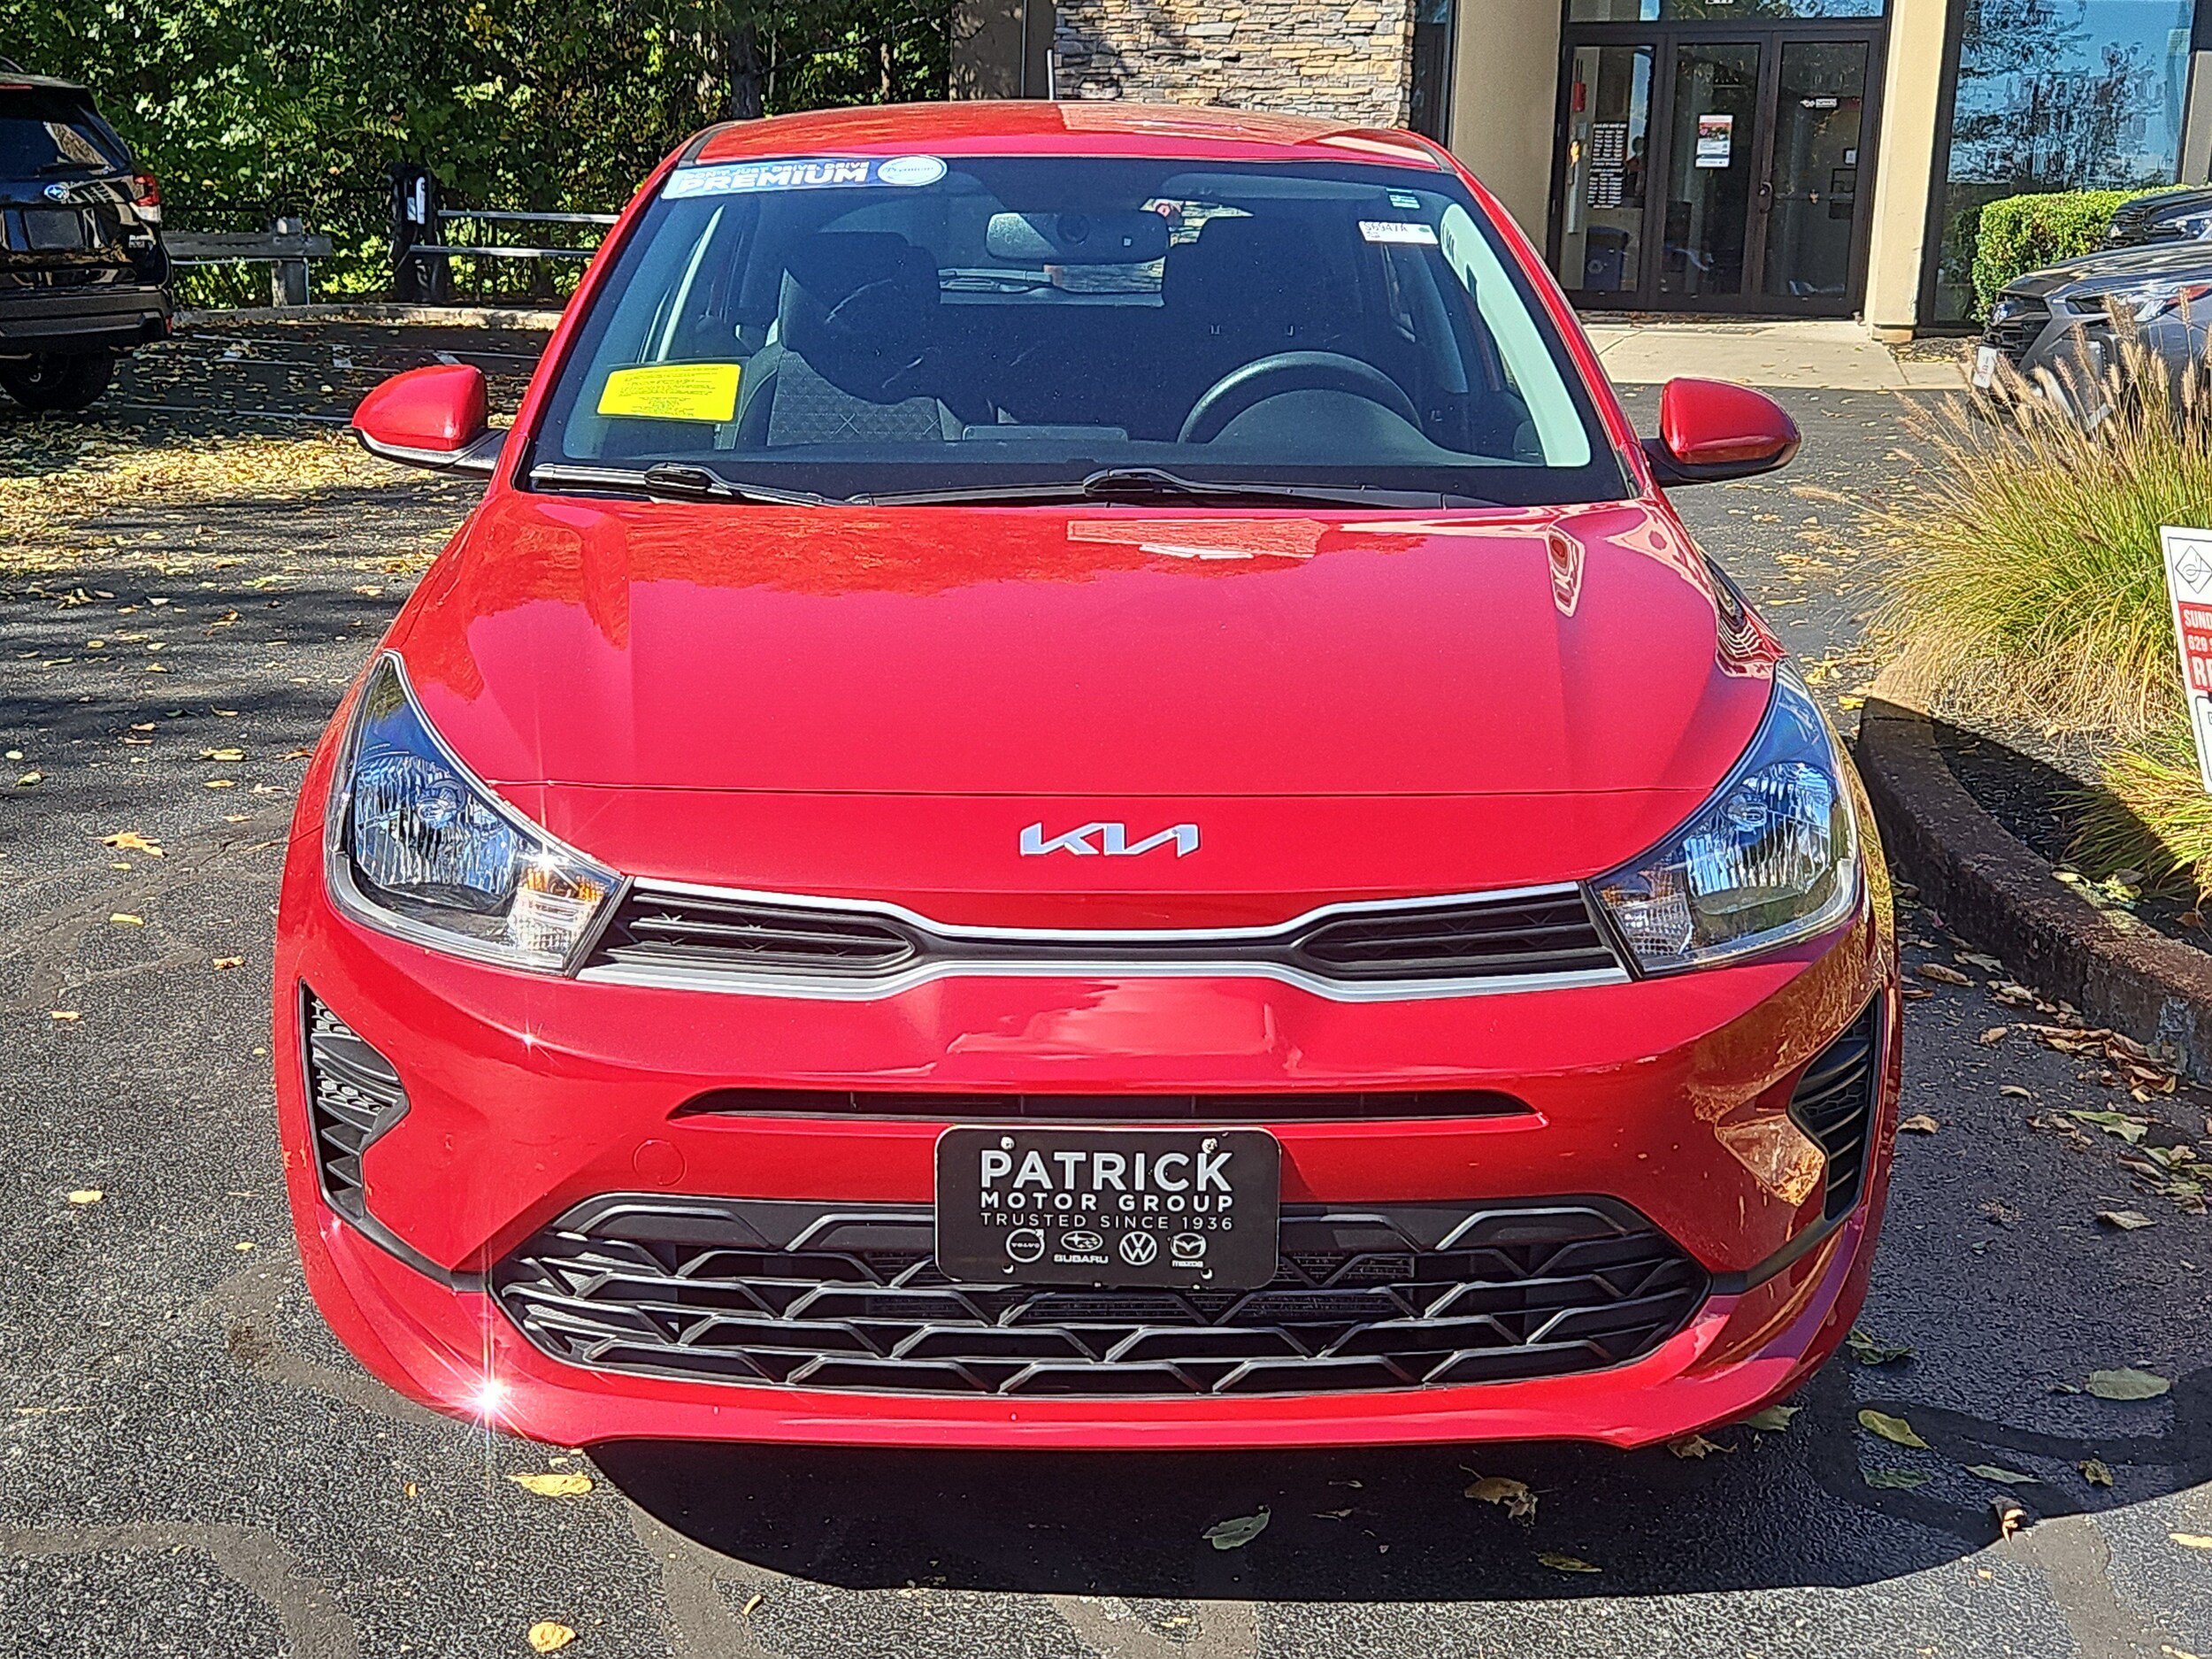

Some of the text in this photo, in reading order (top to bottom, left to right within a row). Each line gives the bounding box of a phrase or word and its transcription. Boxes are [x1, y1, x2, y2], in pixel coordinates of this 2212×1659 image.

[678, 168, 870, 193] PREMIUM
[733, 166, 769, 175] JUST
[1020, 822, 1199, 857] KIA
[980, 1149, 1233, 1192] PATRICK
[980, 1191, 1233, 1213] MOTOR GROUP
[980, 1212, 1233, 1230] TRUSTED SINCE 1936
[1053, 1253, 1109, 1264] SUBARU
